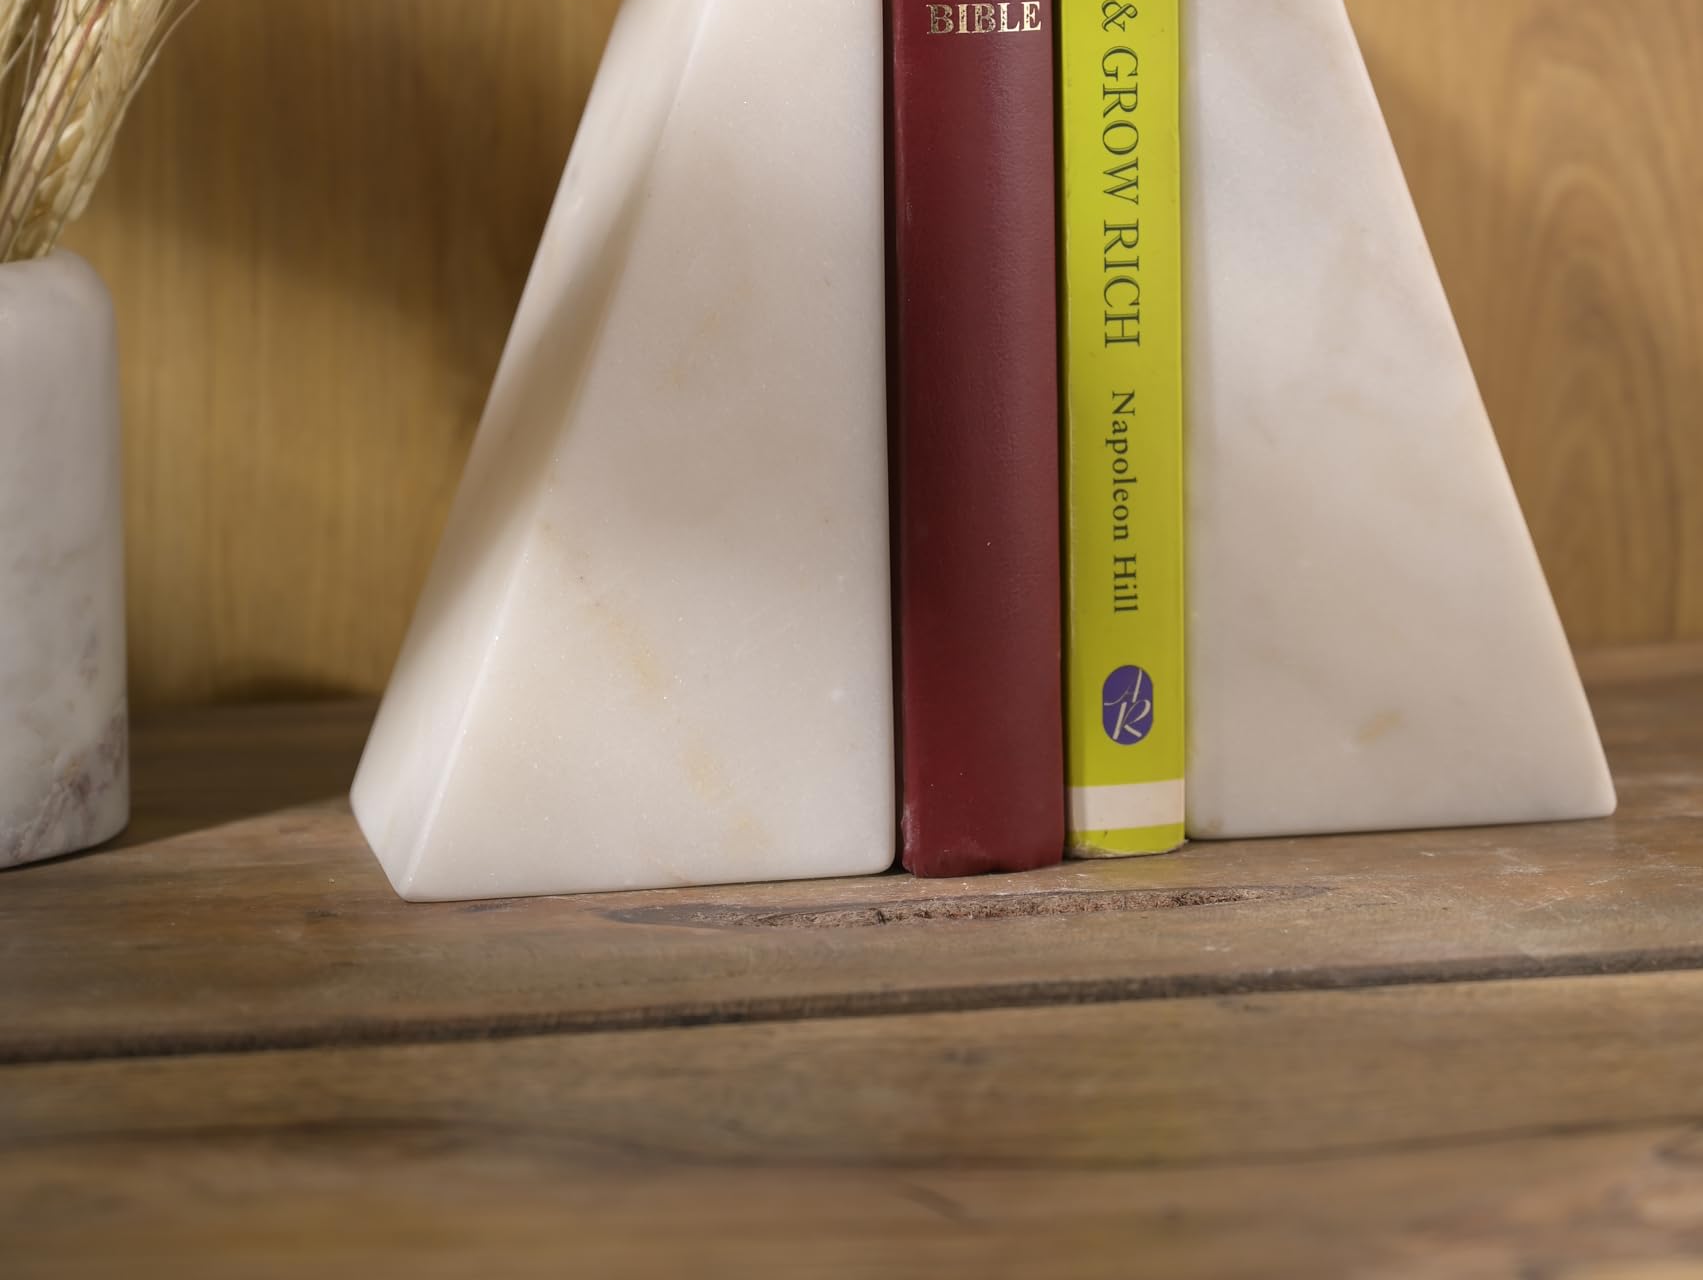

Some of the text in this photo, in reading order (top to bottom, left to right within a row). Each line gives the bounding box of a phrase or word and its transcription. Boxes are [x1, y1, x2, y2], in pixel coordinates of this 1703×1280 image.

[926, 1, 1042, 35] BIBLE
[1102, 45, 1139, 204] GROW
[1103, 219, 1140, 347] RICH
[1105, 390, 1139, 614] Napoleon Hill
